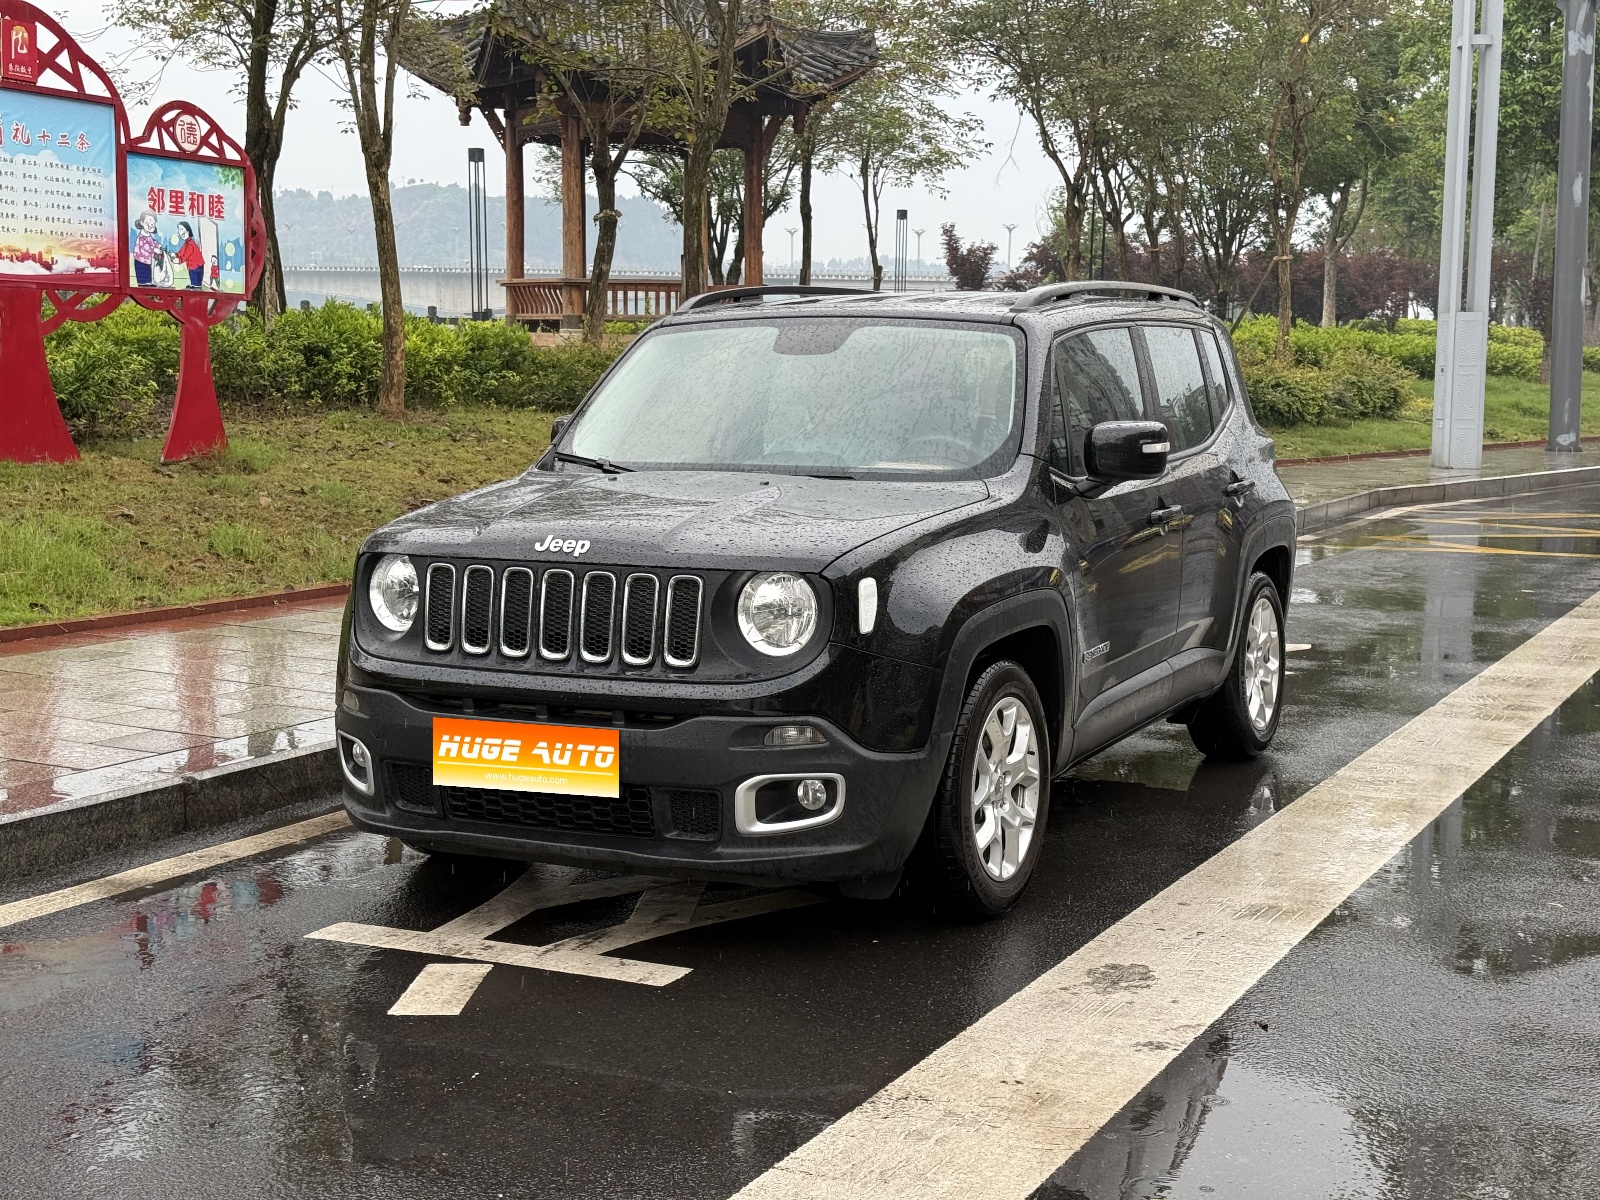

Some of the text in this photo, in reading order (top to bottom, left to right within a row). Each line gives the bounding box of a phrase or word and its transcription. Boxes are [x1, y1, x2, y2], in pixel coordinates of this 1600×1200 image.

[0, 114, 91, 152] 礼十二条
[147, 186, 225, 219] 邻里和睦
[534, 534, 591, 557] Jeep
